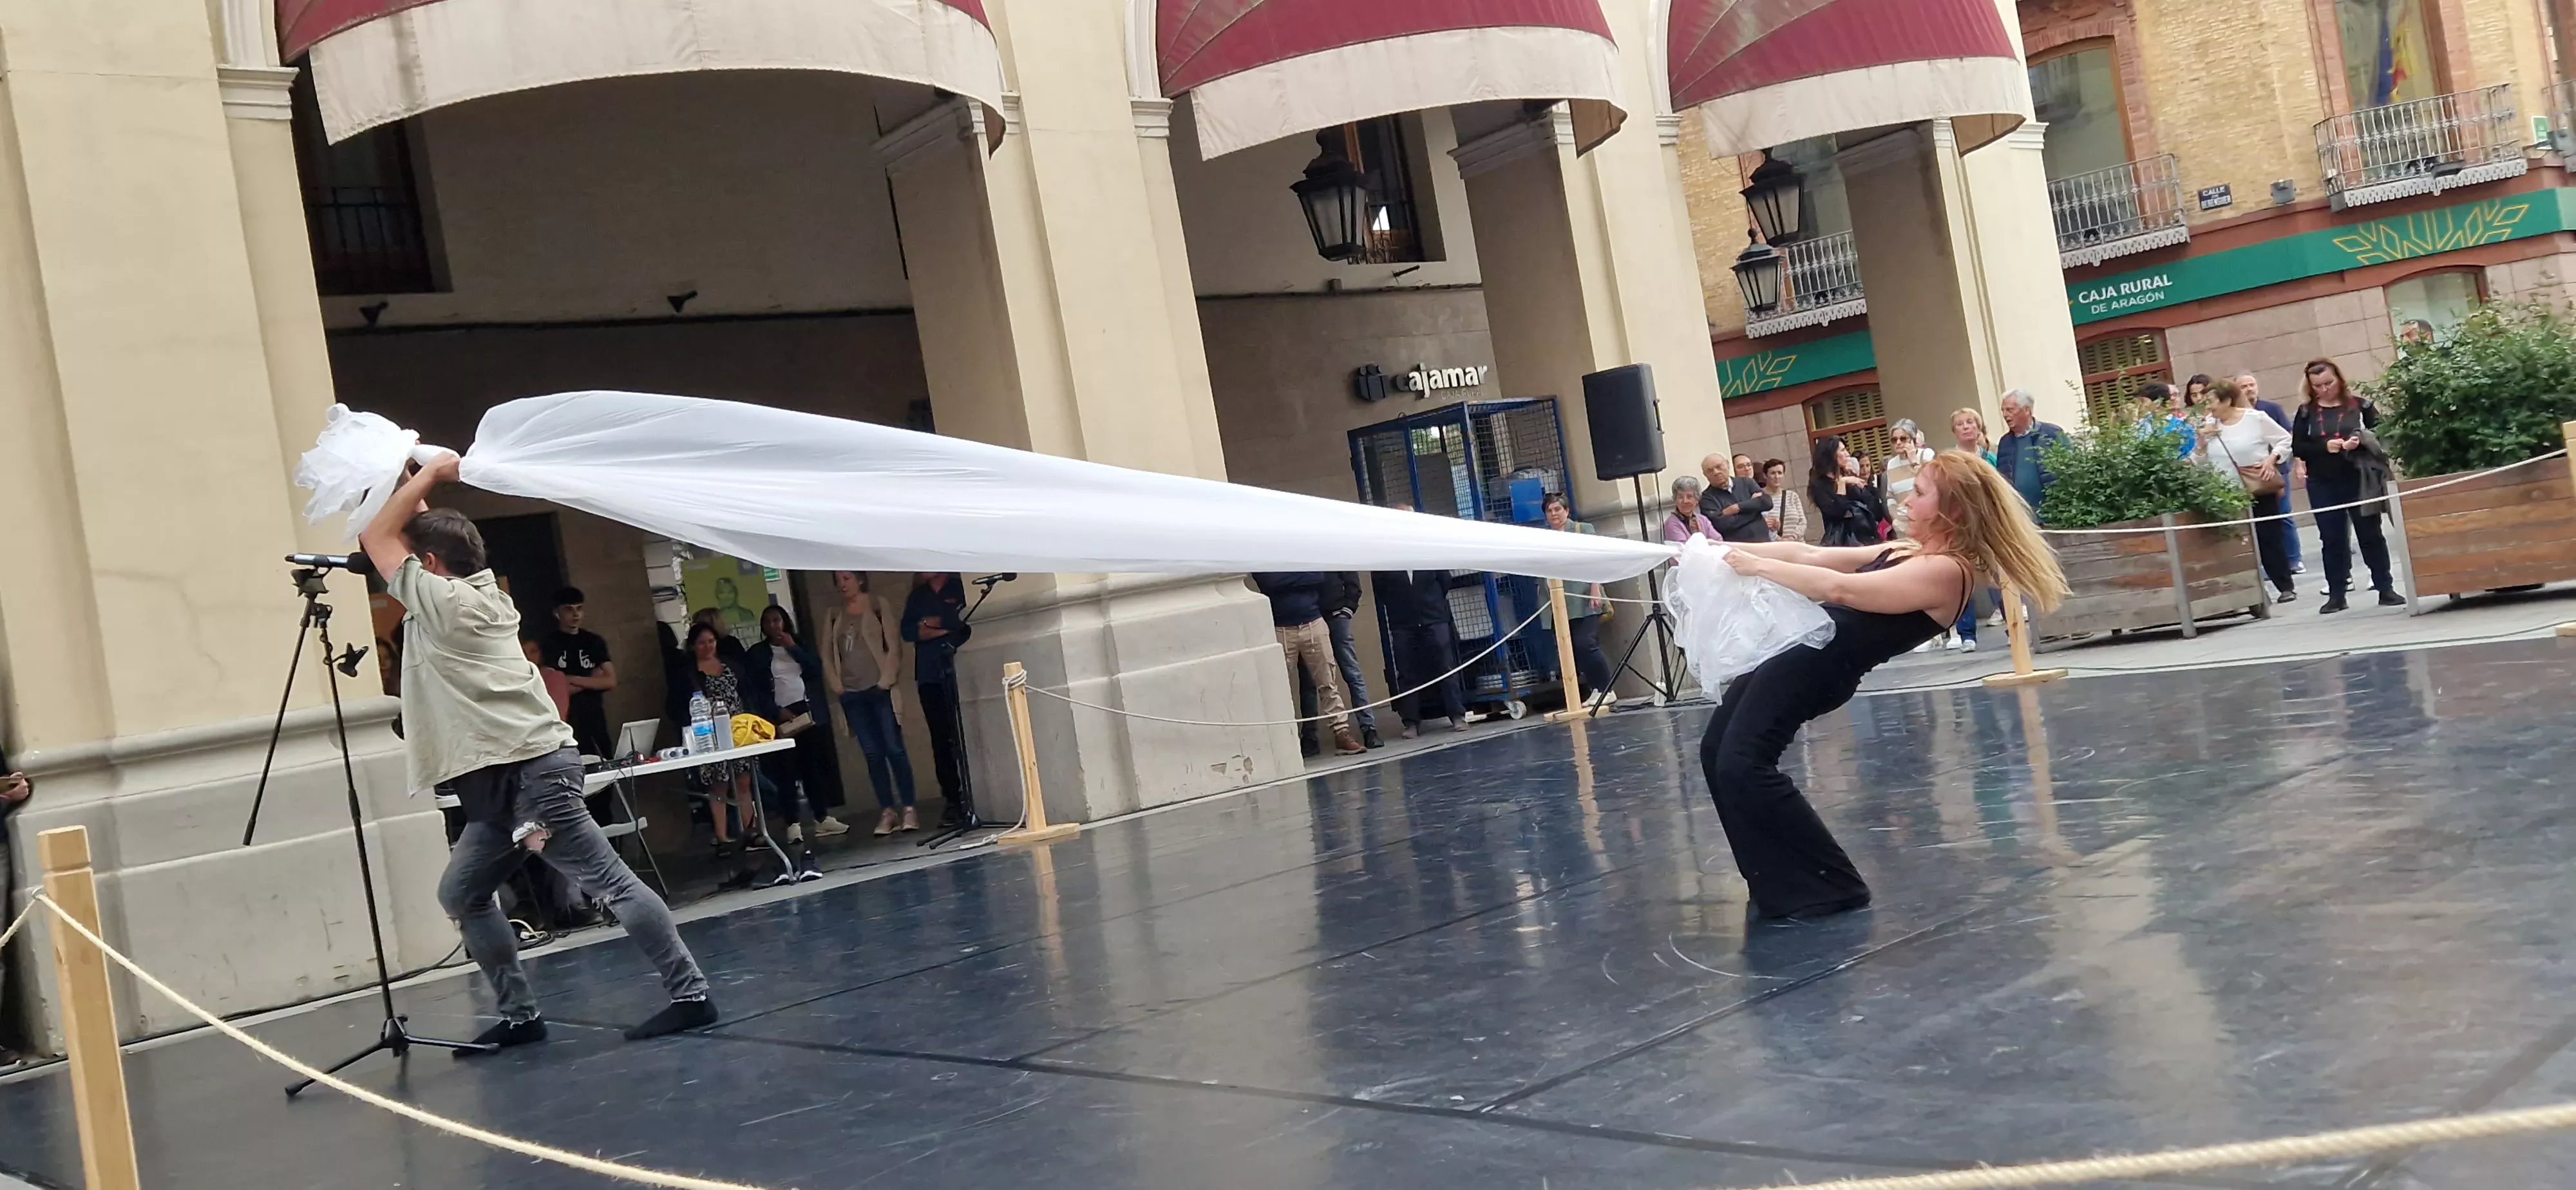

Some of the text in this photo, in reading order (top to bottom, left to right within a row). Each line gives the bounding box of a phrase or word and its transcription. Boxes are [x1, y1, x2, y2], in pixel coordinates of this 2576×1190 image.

[2202, 186, 2226, 196] CALLE
[2078, 274, 2173, 303] CAJA RURAL
[2091, 291, 2165, 314] DE ARAGÓN
